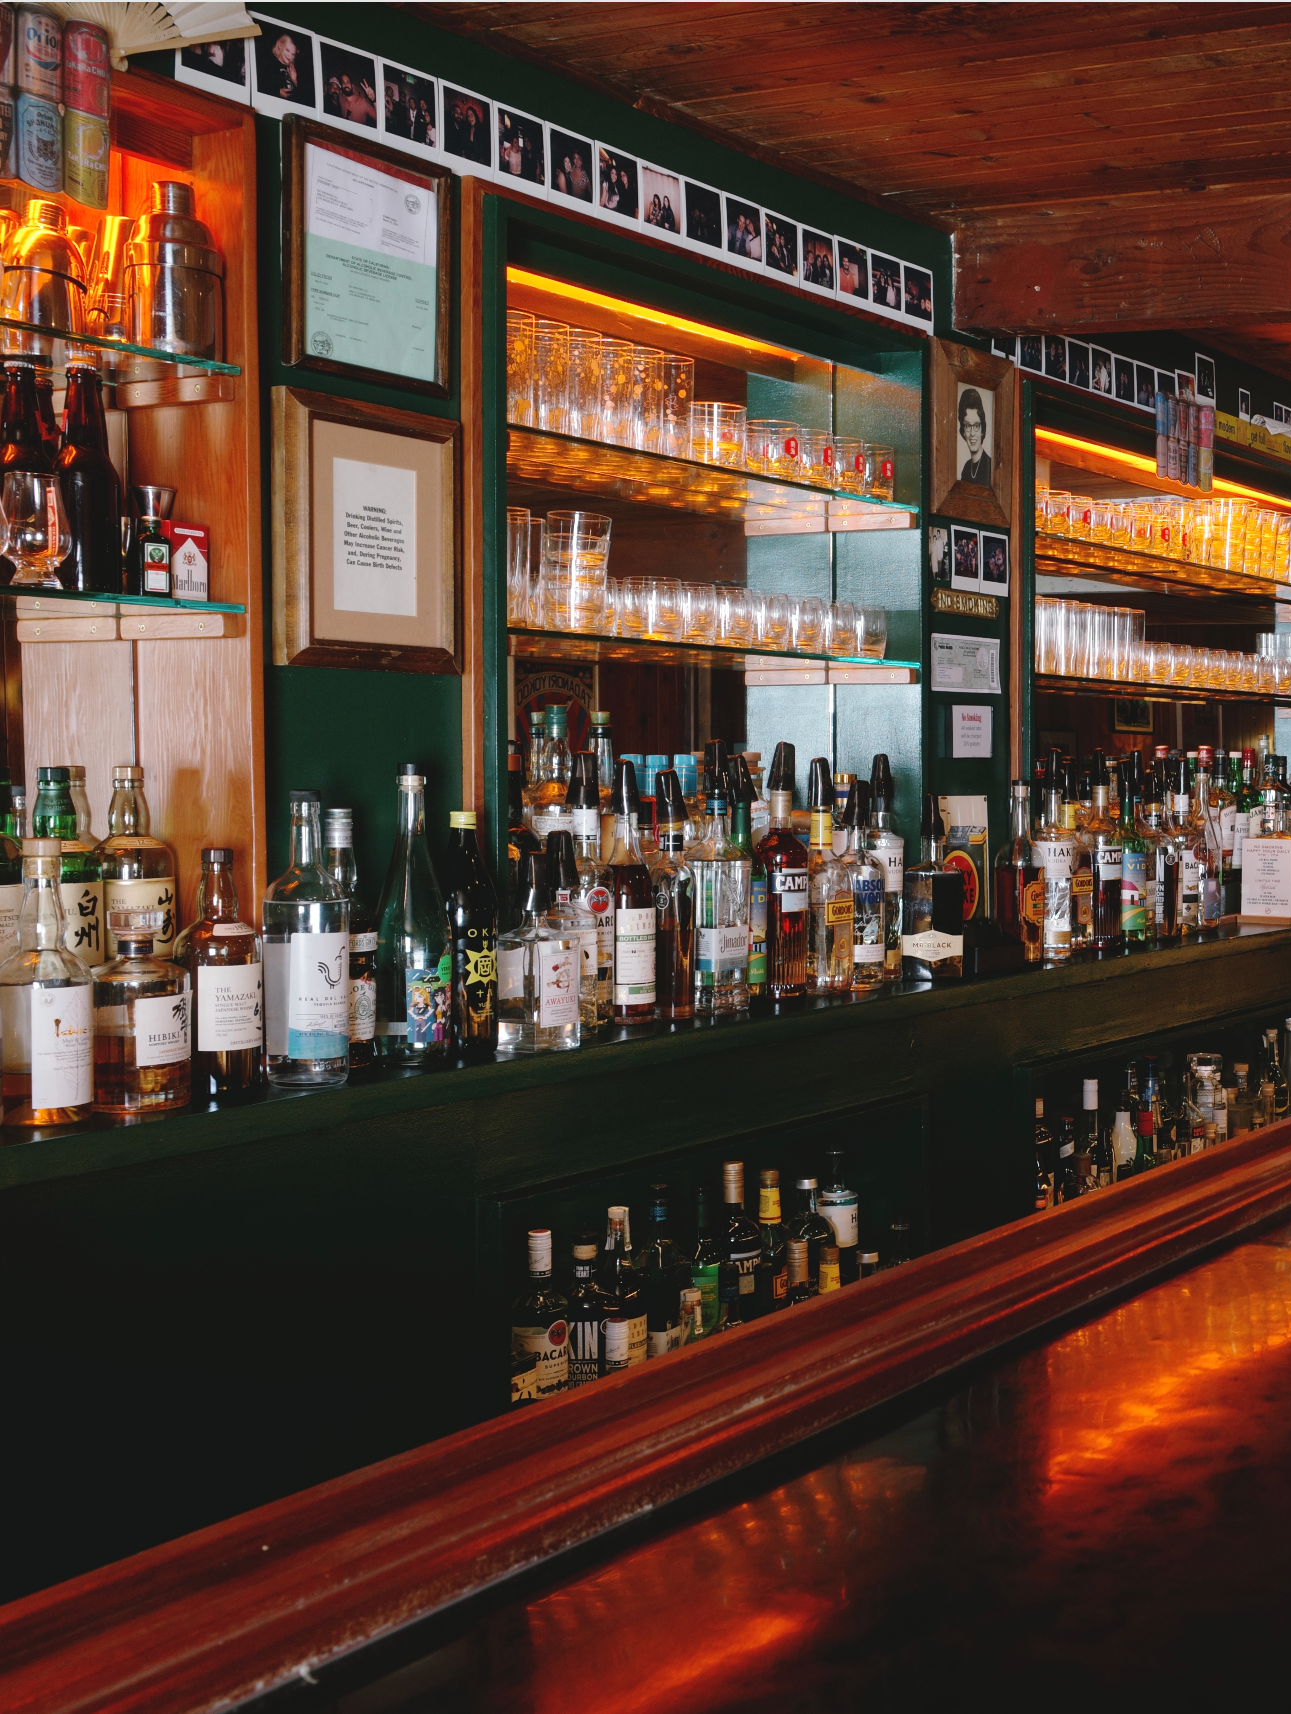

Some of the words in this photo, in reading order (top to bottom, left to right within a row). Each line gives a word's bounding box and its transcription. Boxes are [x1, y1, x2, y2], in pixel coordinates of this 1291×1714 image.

[369, 260, 389, 269] CALIFORNIA
[1218, 420, 1235, 435] modern
[1258, 431, 1266, 445] full
[363, 505, 387, 514] WARNING:
[345, 512, 365, 521] Drinking
[366, 515, 385, 523] Distilled
[387, 518, 403, 526] Spirits,
[360, 524, 379, 532] Coolers,
[344, 530, 357, 538] Other
[381, 536, 404, 544] Beverages
[355, 541, 375, 549] Increase
[359, 551, 375, 559] During
[376, 553, 401, 562] Pregnancy,
[171, 569, 207, 594] Marlboro
[938, 592, 952, 608] NO
[953, 595, 996, 617] SMOKING
[961, 713, 967, 721] No
[966, 713, 982, 723] Smoking
[1047, 848, 1073, 857] HAK
[1097, 851, 1122, 864] CAMP
[888, 856, 902, 868] HA
[775, 875, 808, 890] CAMP
[855, 879, 885, 892] ABSOL
[860, 892, 885, 905] VODK
[74, 889, 99, 951] 白州
[720, 931, 747, 953] Jimador
[926, 941, 952, 949] BLACK
[545, 995, 576, 1007] AWAYUKI
[575, 1270, 590, 1278] HEART
[535, 1349, 568, 1362] BACAR
[567, 1363, 598, 1373] ROWN
[567, 1373, 598, 1381] OURBON
